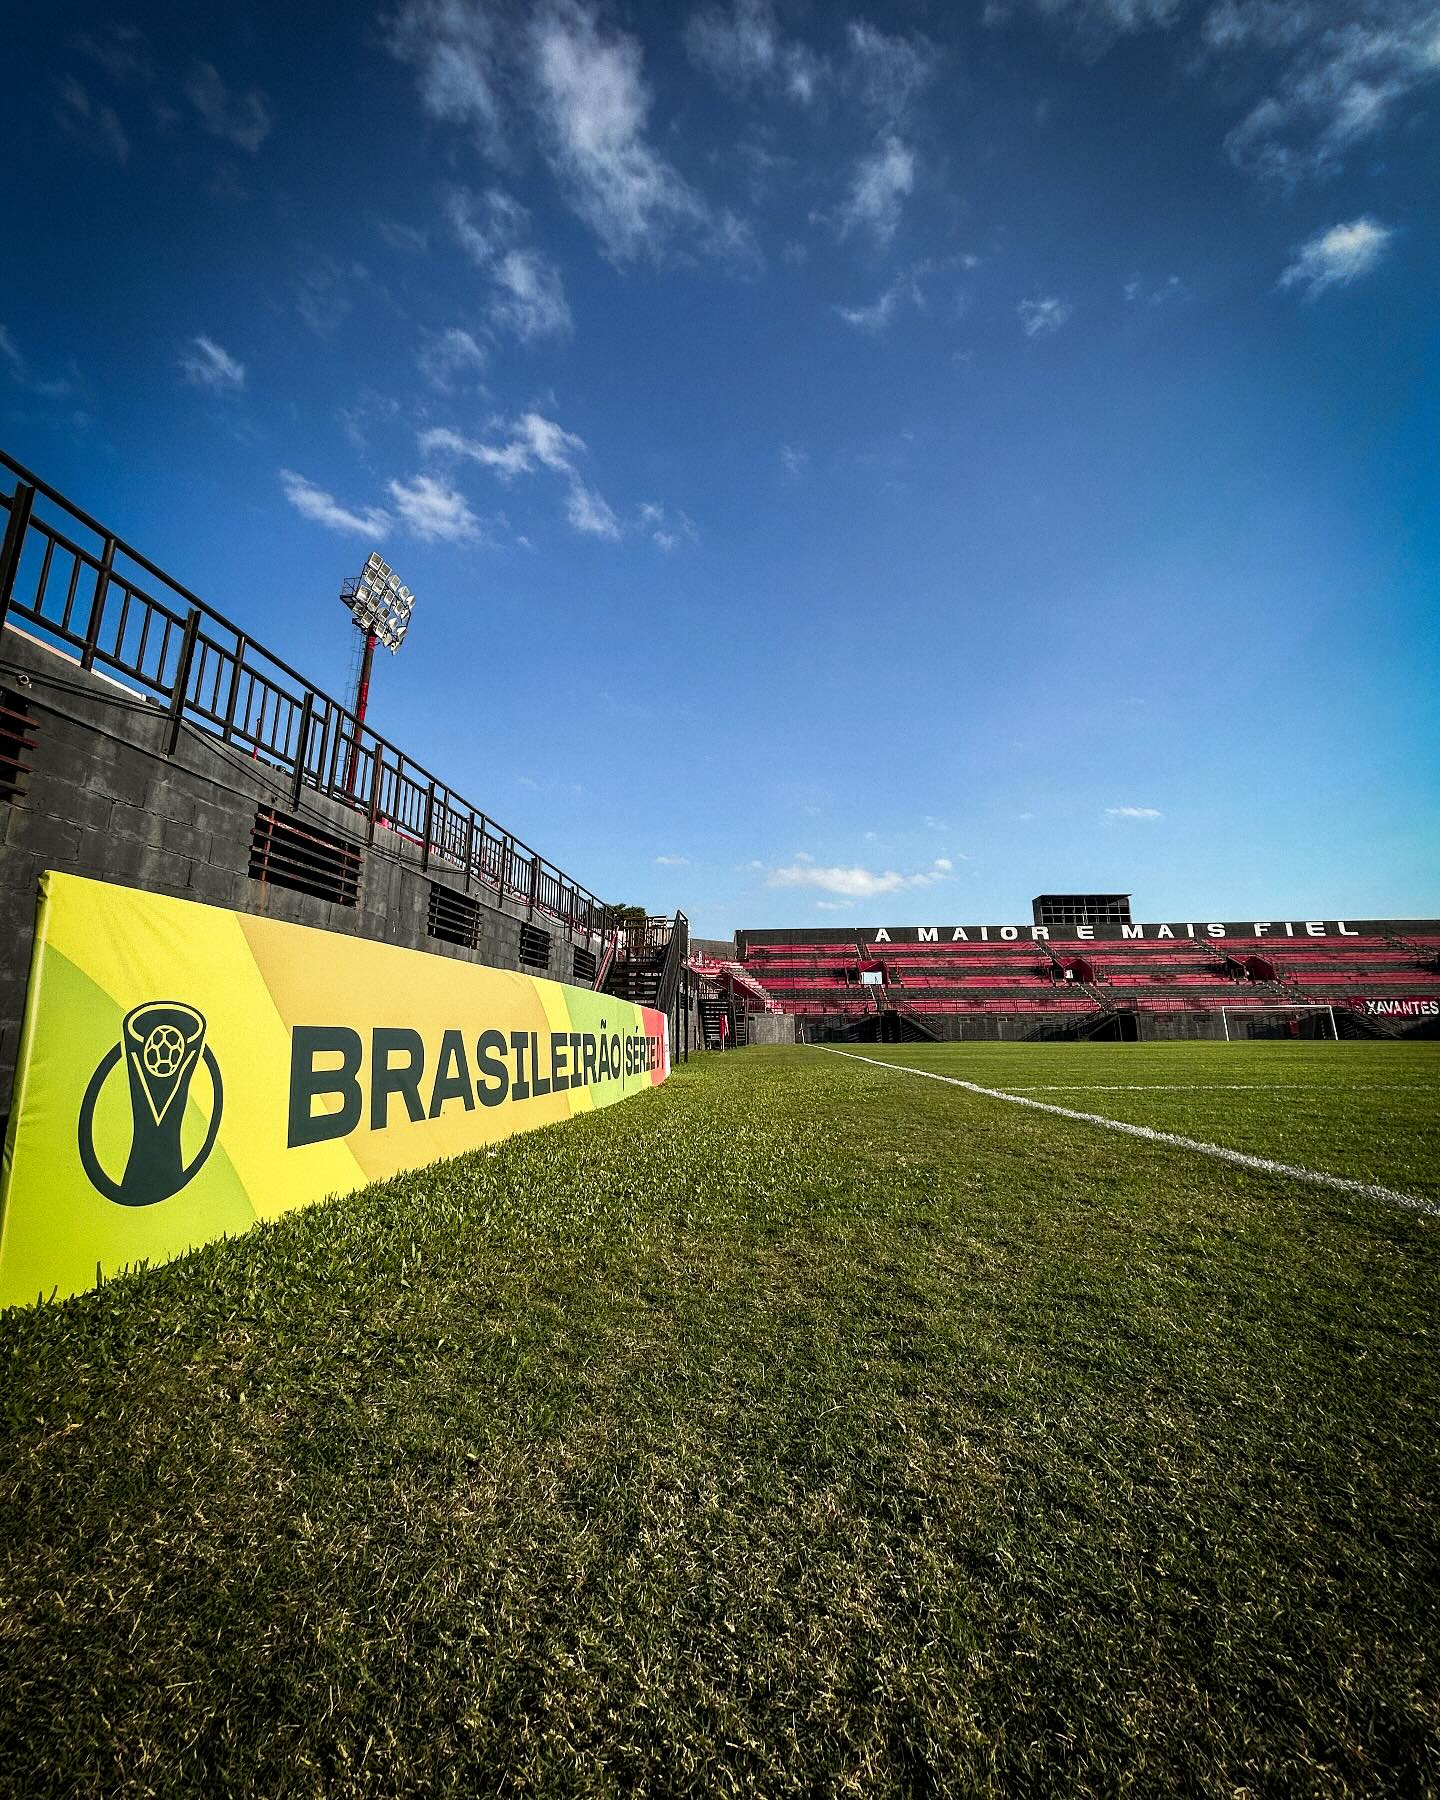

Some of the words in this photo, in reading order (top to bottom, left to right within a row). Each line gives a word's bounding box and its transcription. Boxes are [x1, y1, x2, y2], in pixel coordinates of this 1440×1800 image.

[874, 928, 892, 943] A
[917, 926, 1050, 943] MAIOR
[1076, 925, 1095, 940] E
[1121, 923, 1226, 939] MAIS
[1254, 921, 1359, 937] FIEL
[1366, 1000, 1439, 1015] XAVANTES
[287, 1018, 621, 1149] BRASILEIRÃO
[625, 1025, 656, 1077] SÉRIE
